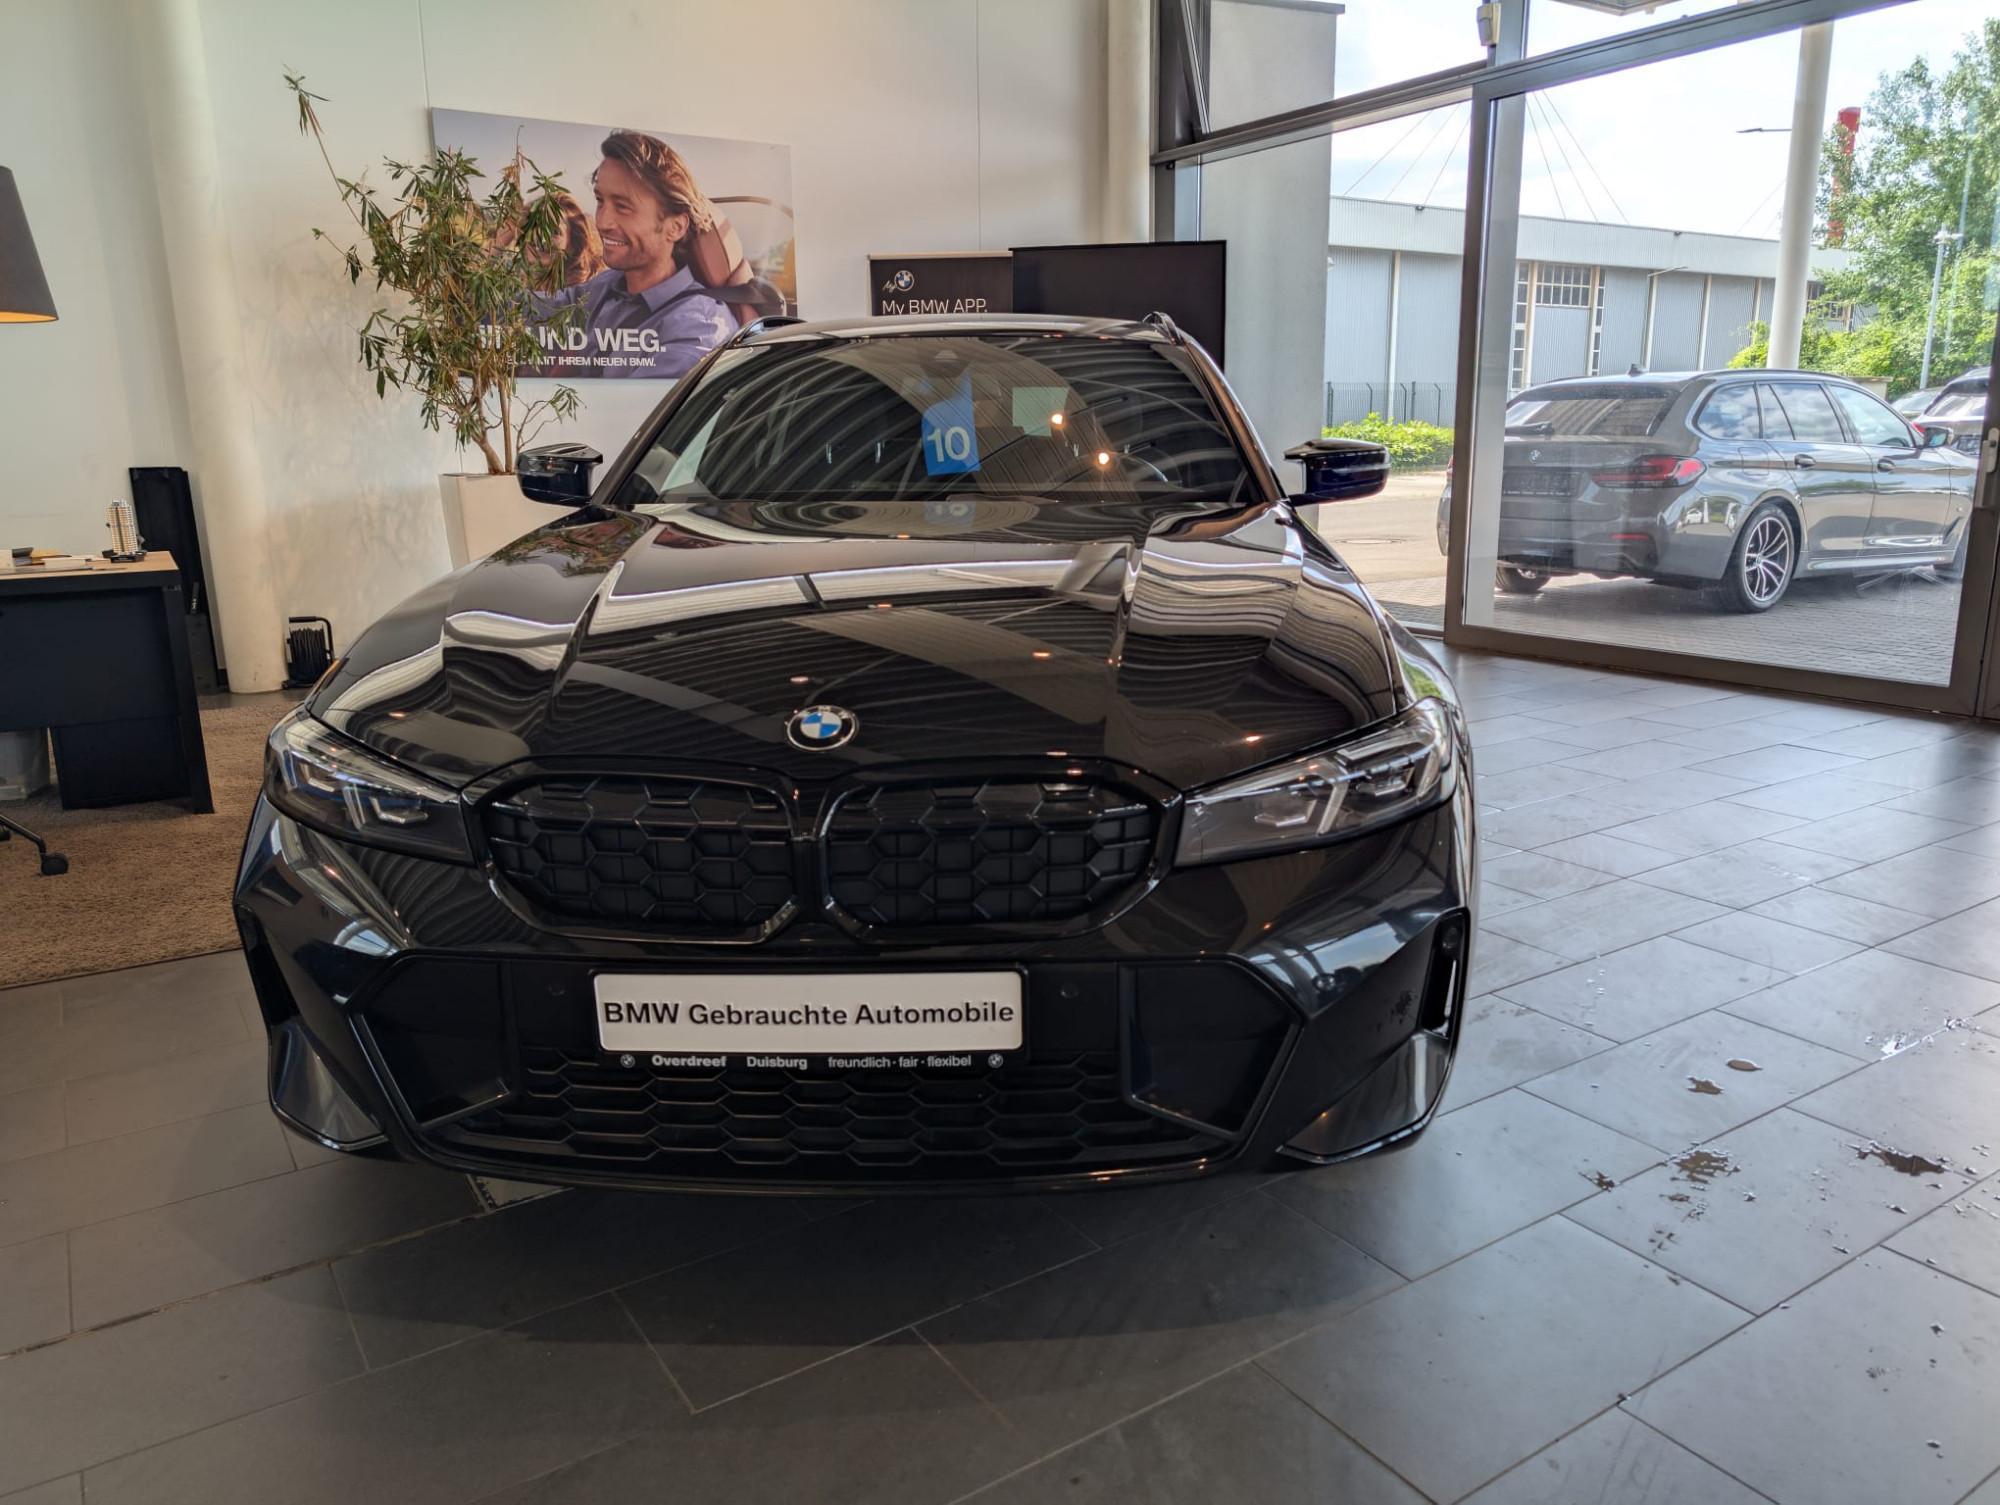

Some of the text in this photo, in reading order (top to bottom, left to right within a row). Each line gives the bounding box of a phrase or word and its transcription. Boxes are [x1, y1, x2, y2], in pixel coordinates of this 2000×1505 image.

[882, 299, 988, 315] My BMW APP.
[594, 328, 667, 353] WEG.
[558, 356, 591, 367] IHREM
[593, 356, 628, 367] NEUEN
[629, 356, 657, 367] BMW.
[927, 426, 971, 463] 10
[604, 1002, 1014, 1025] BMW Gebrauchte Automobile
[652, 1054, 972, 1070] Overdreef Duisburg freundlich fair flexibel
